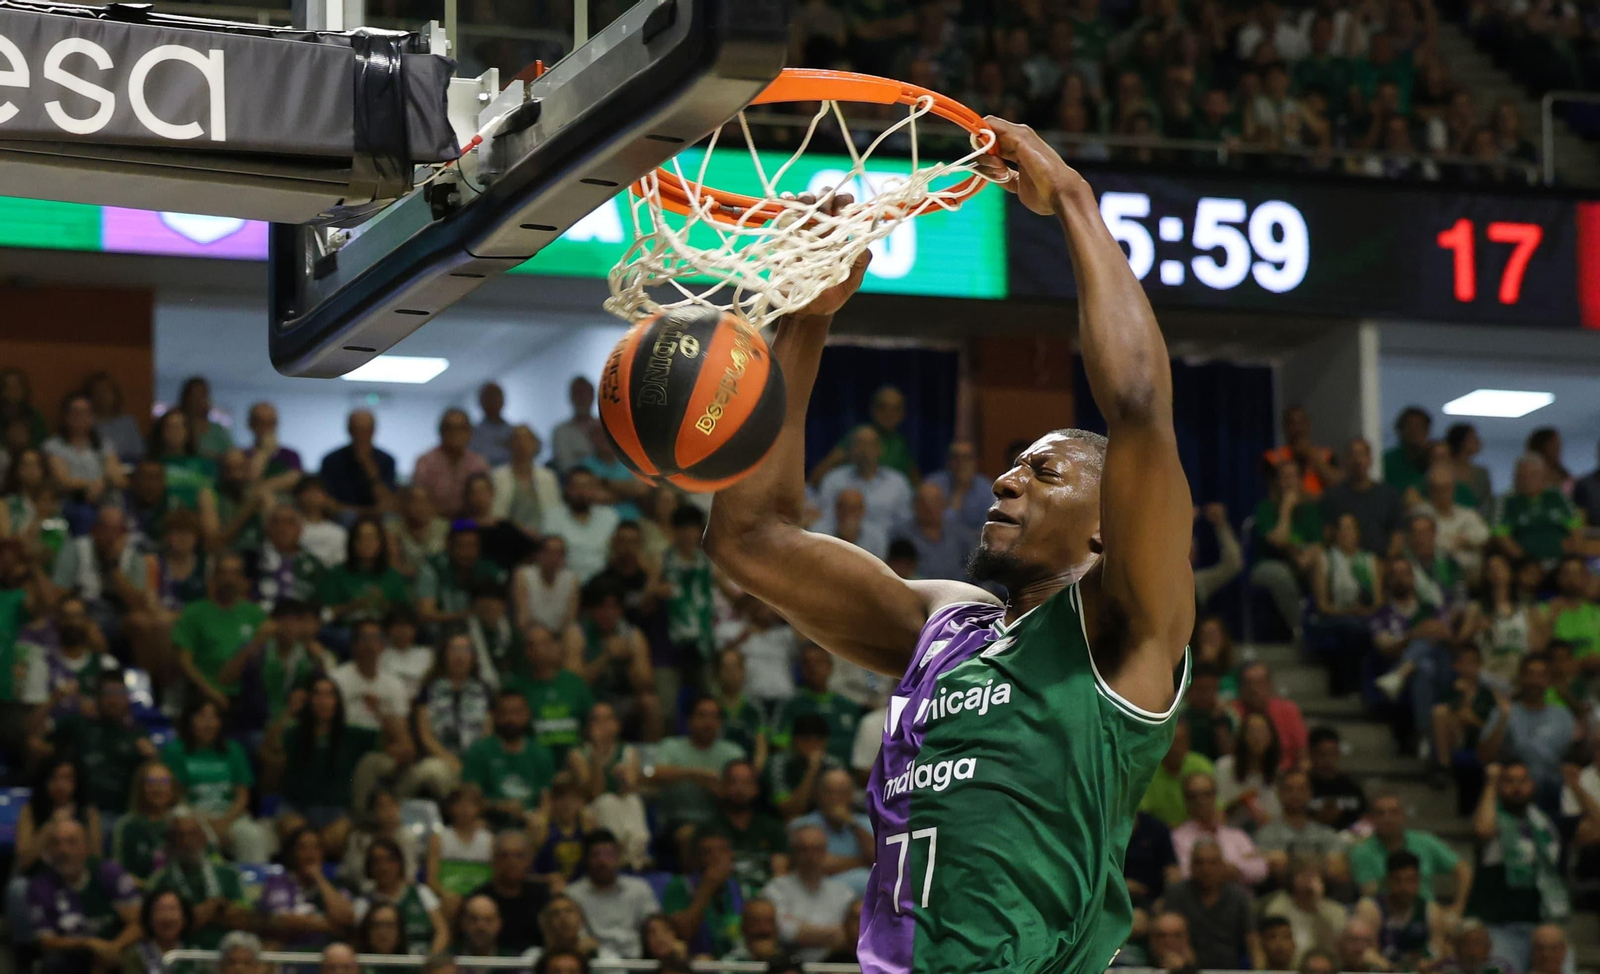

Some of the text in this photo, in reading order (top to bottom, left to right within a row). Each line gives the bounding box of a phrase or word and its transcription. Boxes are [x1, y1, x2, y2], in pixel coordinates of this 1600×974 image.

[1100, 192, 1311, 293] 5:59
[1437, 219, 1543, 305] 17
[886, 827, 938, 913] 77
